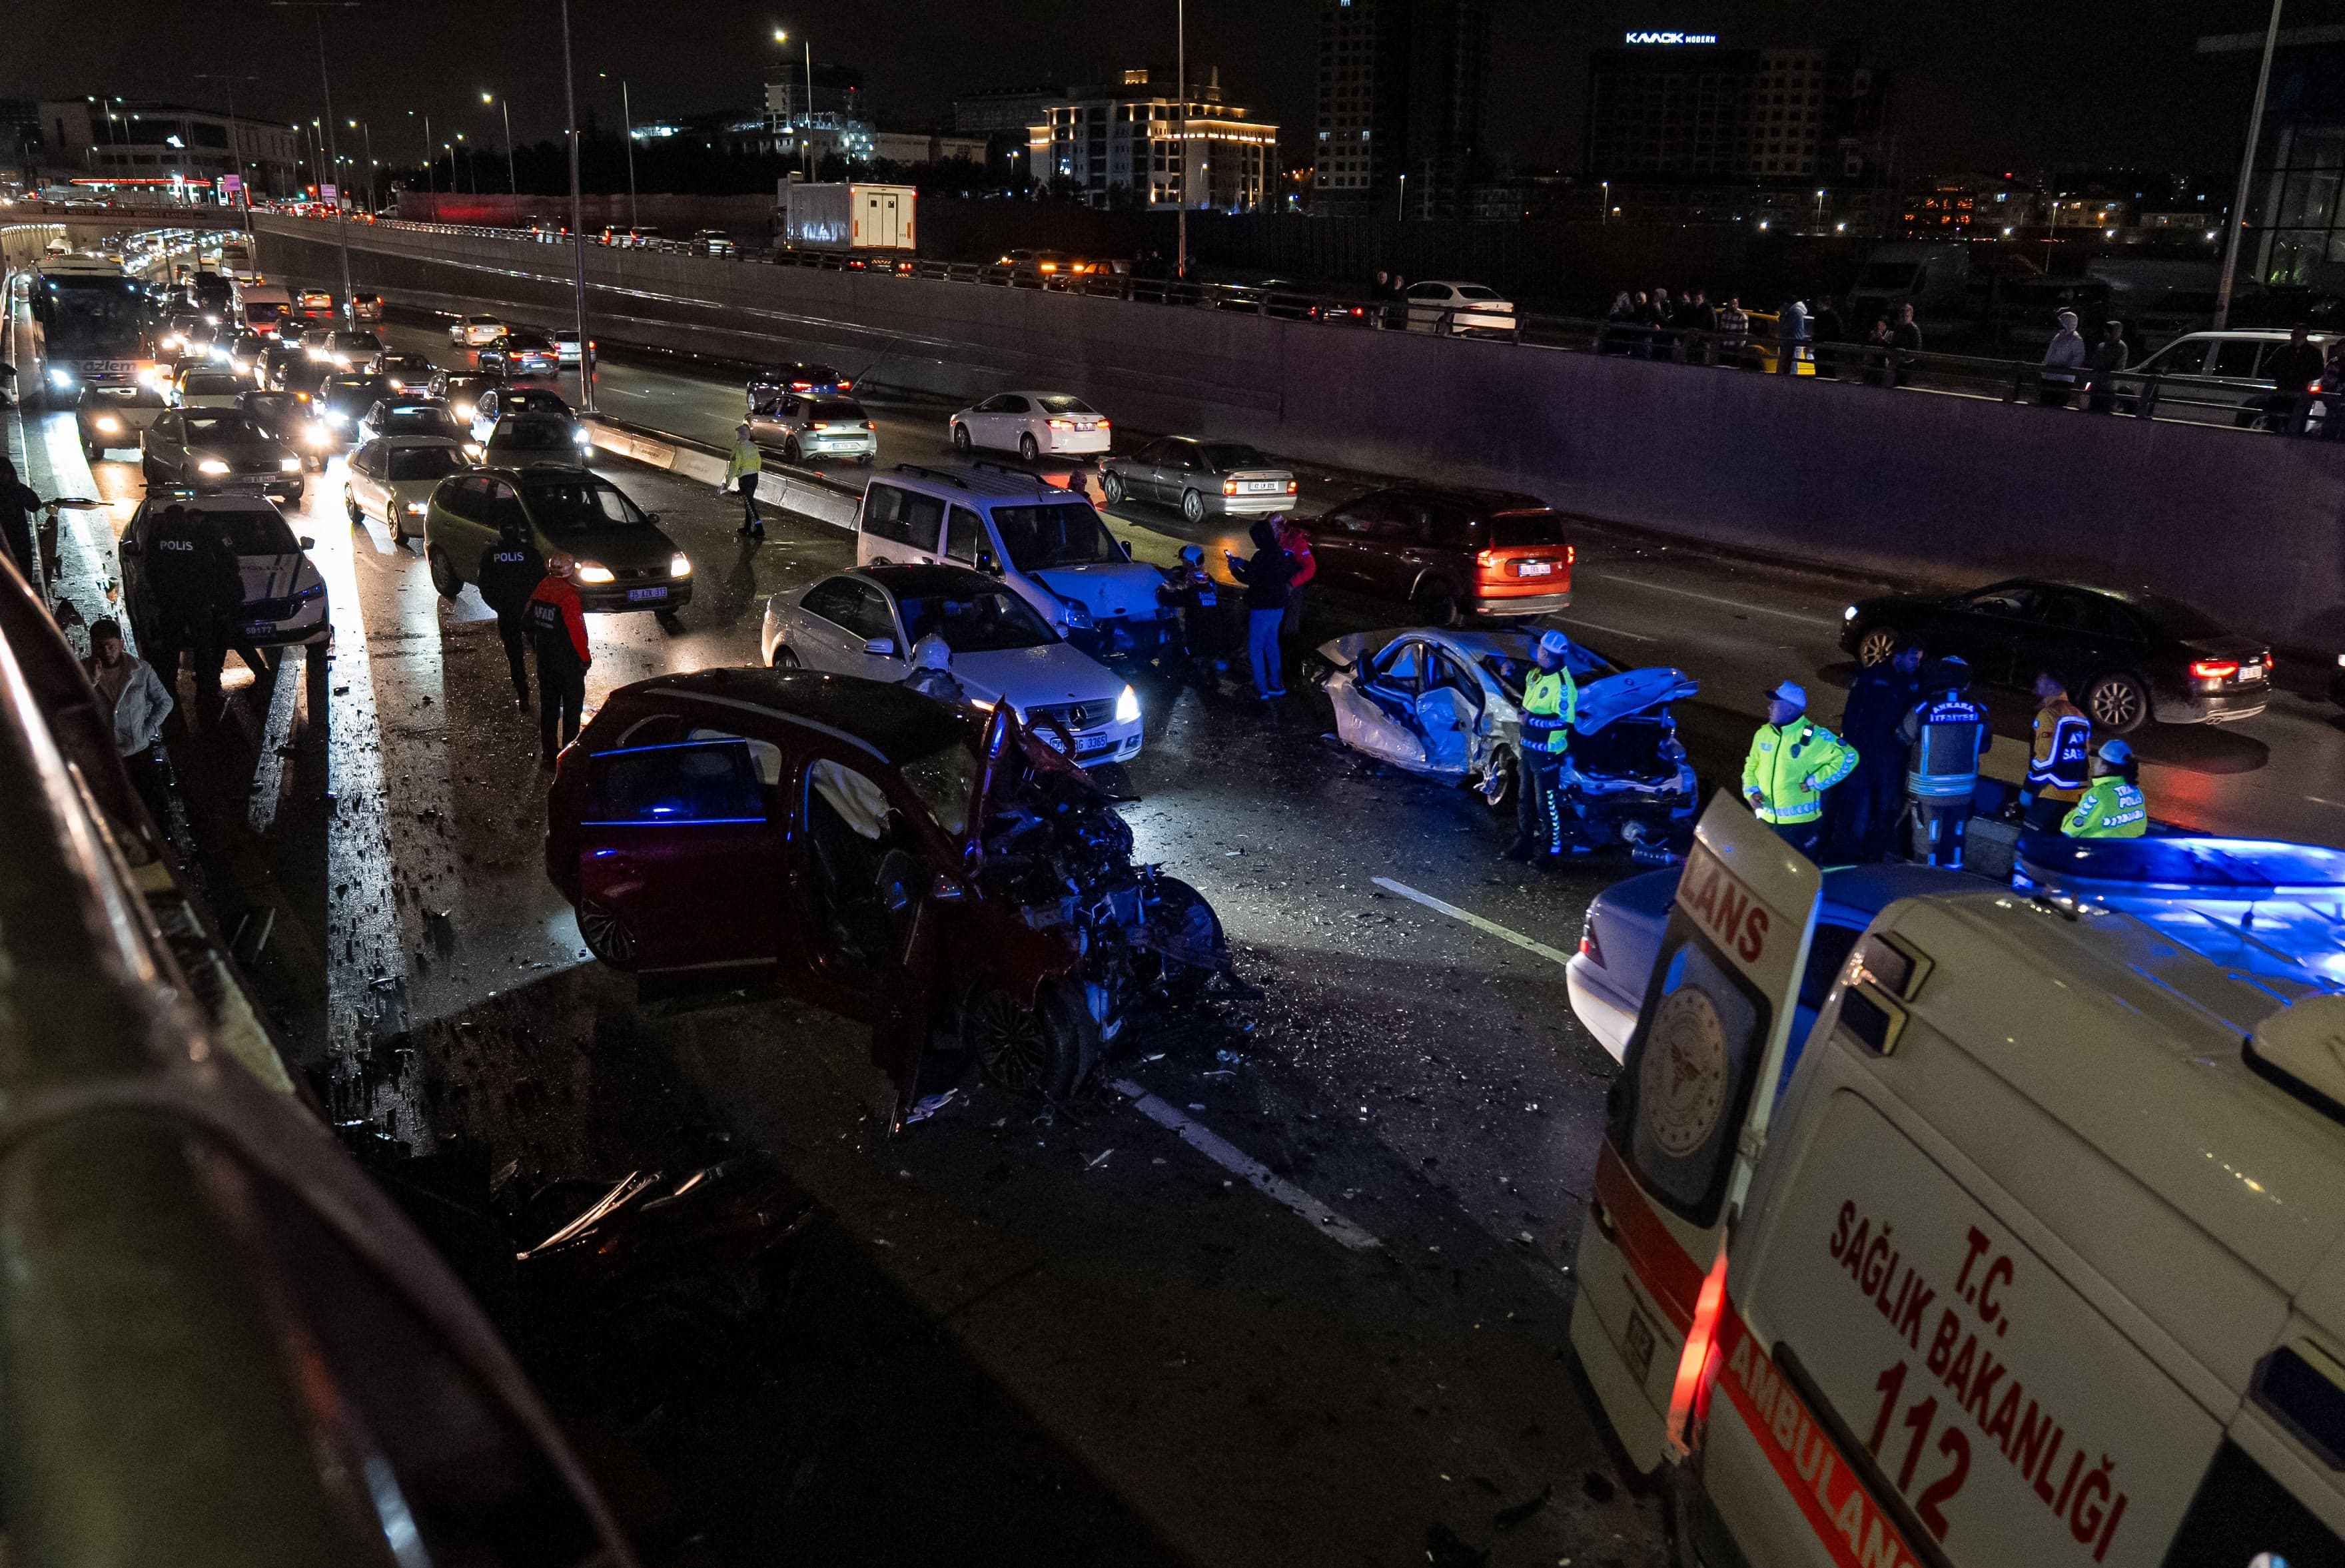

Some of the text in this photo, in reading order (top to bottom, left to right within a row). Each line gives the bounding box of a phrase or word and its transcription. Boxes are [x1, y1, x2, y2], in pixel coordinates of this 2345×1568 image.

[84, 361, 136, 372] özlem
[1956, 1226, 2013, 1338] T.C.
[1830, 1200, 2128, 1563] SAĞLIK BAKANLIĞI
[1867, 1360, 1971, 1544] 112
